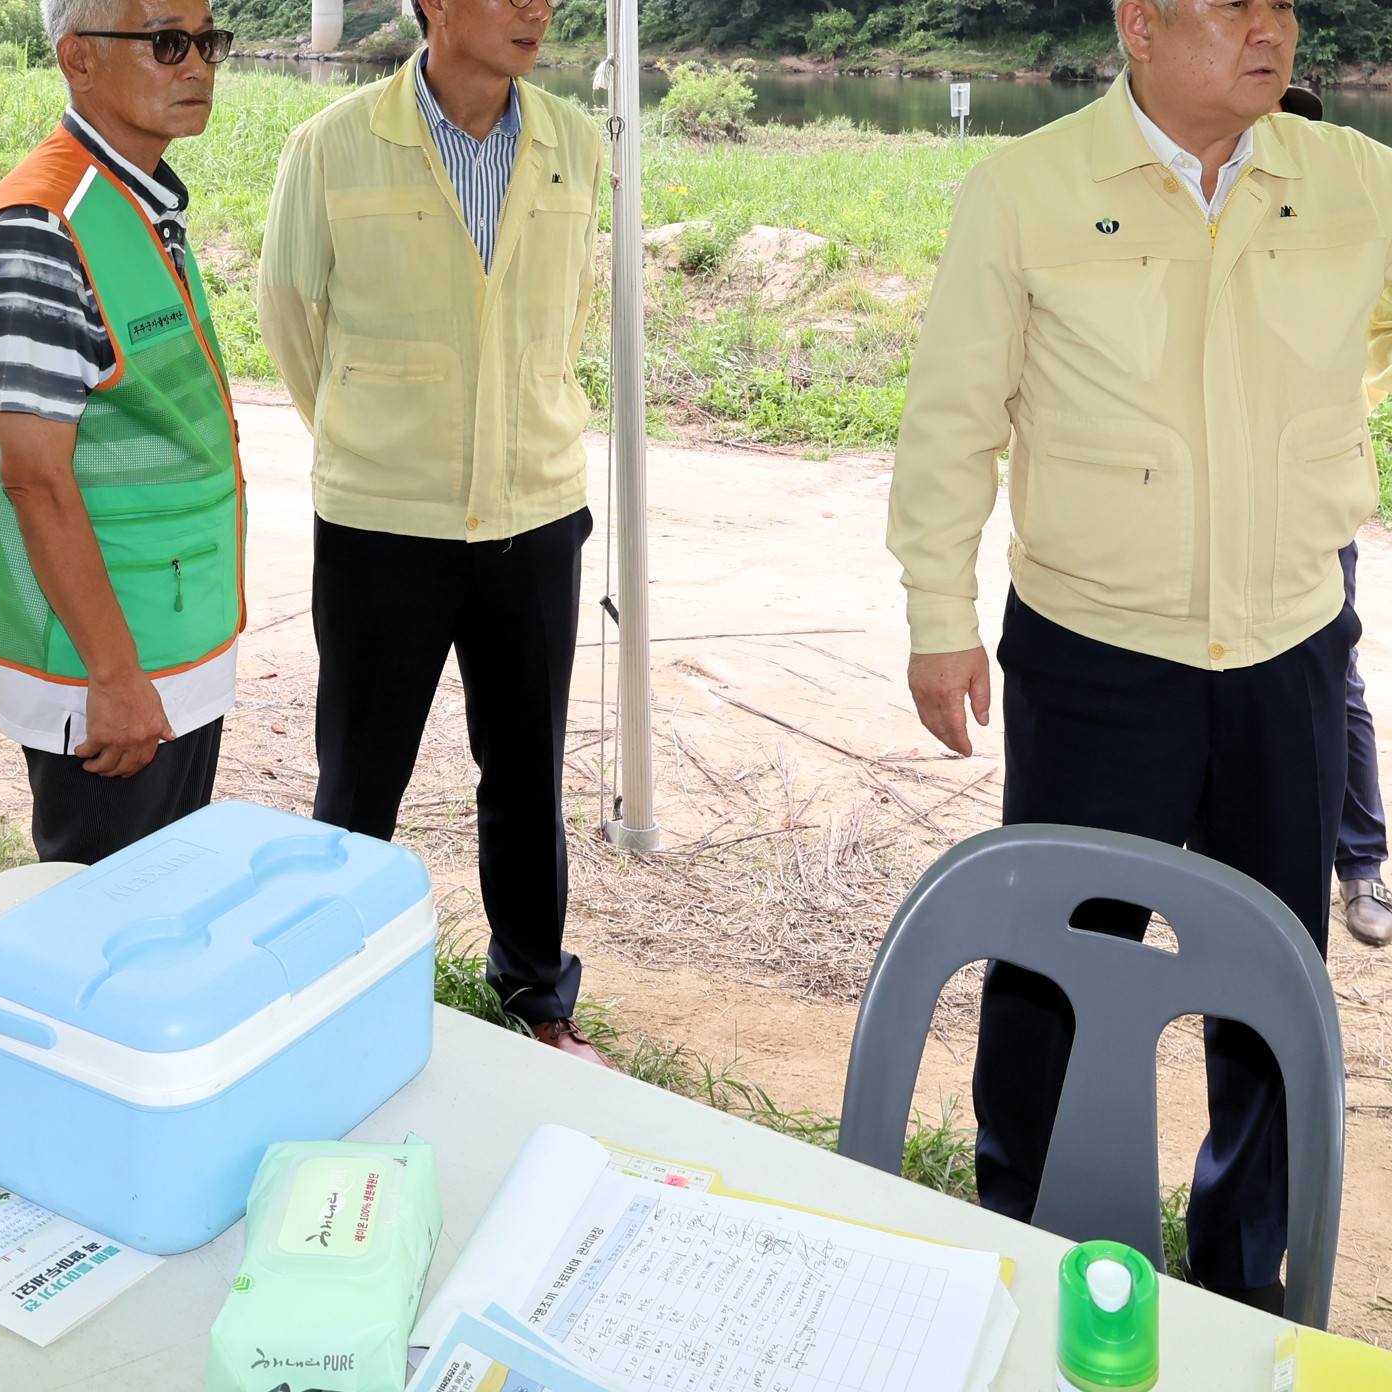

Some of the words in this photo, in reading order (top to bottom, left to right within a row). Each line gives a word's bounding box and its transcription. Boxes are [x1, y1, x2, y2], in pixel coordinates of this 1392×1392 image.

[363, 1172, 380, 1203] 생분해원단
[359, 1203, 373, 1222] 100%
[354, 1222, 369, 1243] 레이온
[80, 1240, 102, 1253] 꼭
[88, 1243, 120, 1266] 물에
[10, 1249, 87, 1301] 알아두세요!
[35, 1260, 94, 1301] 들어가기
[528, 1290, 559, 1324] 구명조끼
[552, 1256, 582, 1290] 무료대여
[575, 1225, 604, 1257] 관리대장
[19, 1297, 42, 1313] 전
[323, 1353, 355, 1372] PURE
[436, 1361, 460, 1392] 안전장비
